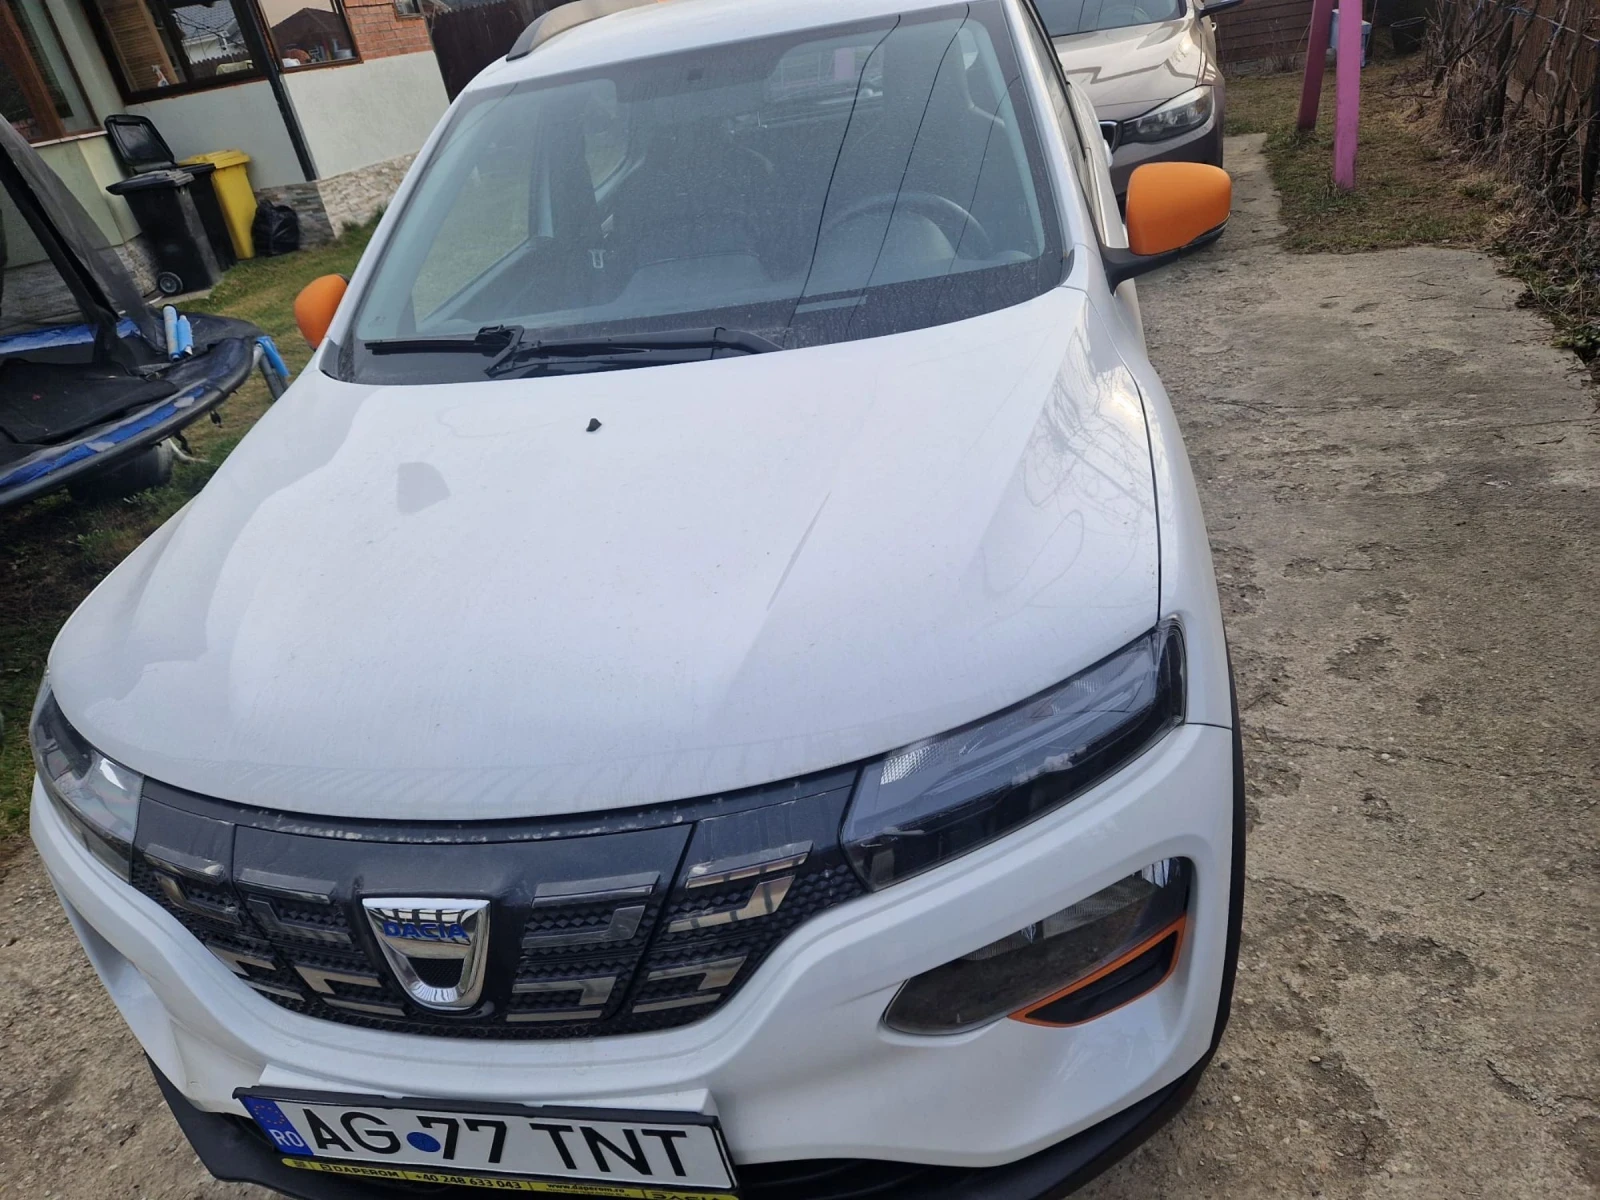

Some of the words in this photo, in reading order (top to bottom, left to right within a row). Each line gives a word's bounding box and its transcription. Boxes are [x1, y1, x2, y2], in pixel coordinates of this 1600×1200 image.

[383, 922, 469, 939] DACIA
[268, 1129, 304, 1147] RO
[302, 1108, 401, 1154] AG
[416, 1115, 507, 1164] 77
[529, 1122, 687, 1177] TNT
[333, 1165, 399, 1178] DAPEROM
[416, 1173, 438, 1182] +40
[440, 1175, 466, 1184] 248
[469, 1178, 493, 1188] 633
[497, 1180, 522, 1189] 043
